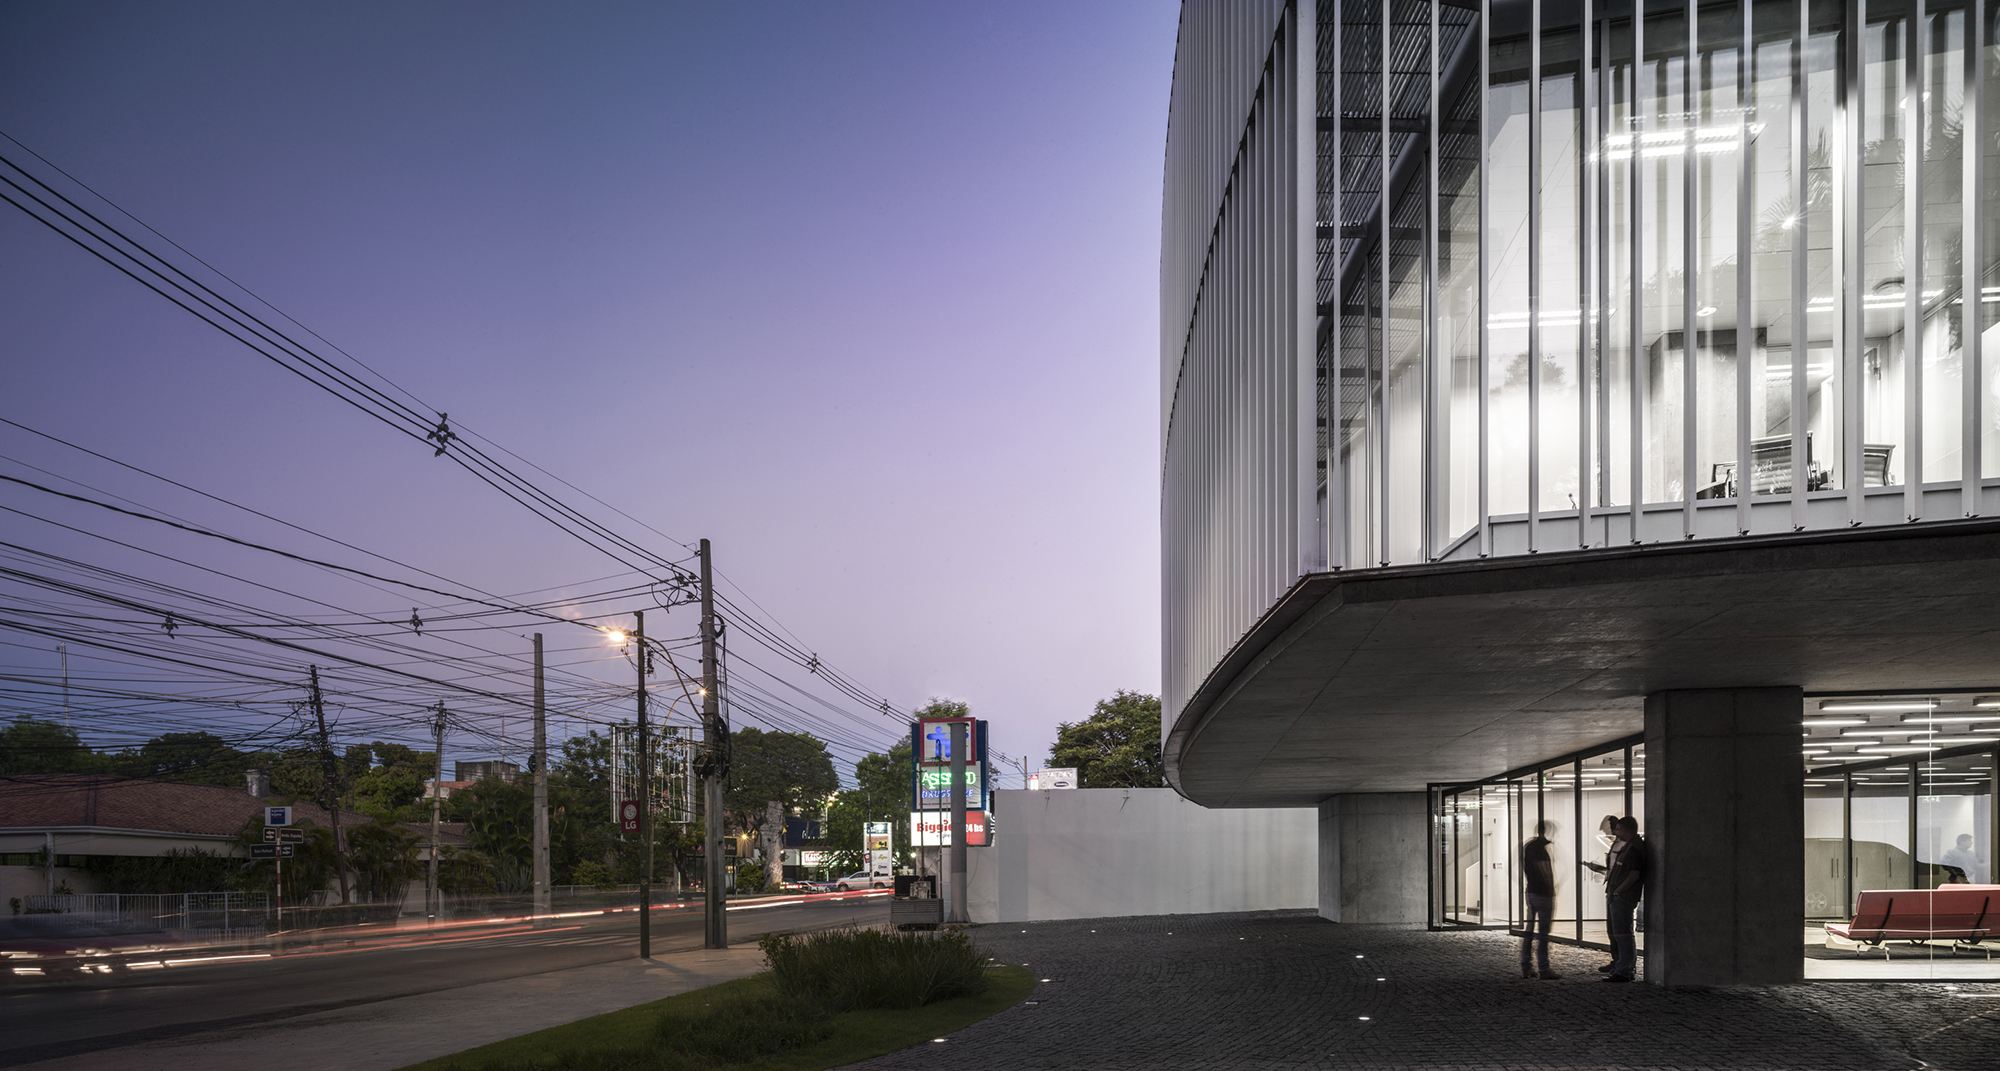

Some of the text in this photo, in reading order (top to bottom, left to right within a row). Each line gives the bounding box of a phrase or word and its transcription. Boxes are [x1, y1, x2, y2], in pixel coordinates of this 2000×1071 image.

[921, 771, 976, 790] ASISD
[921, 789, 974, 799] DRUGSE
[625, 820, 637, 830] LG
[974, 823, 984, 833] hs
